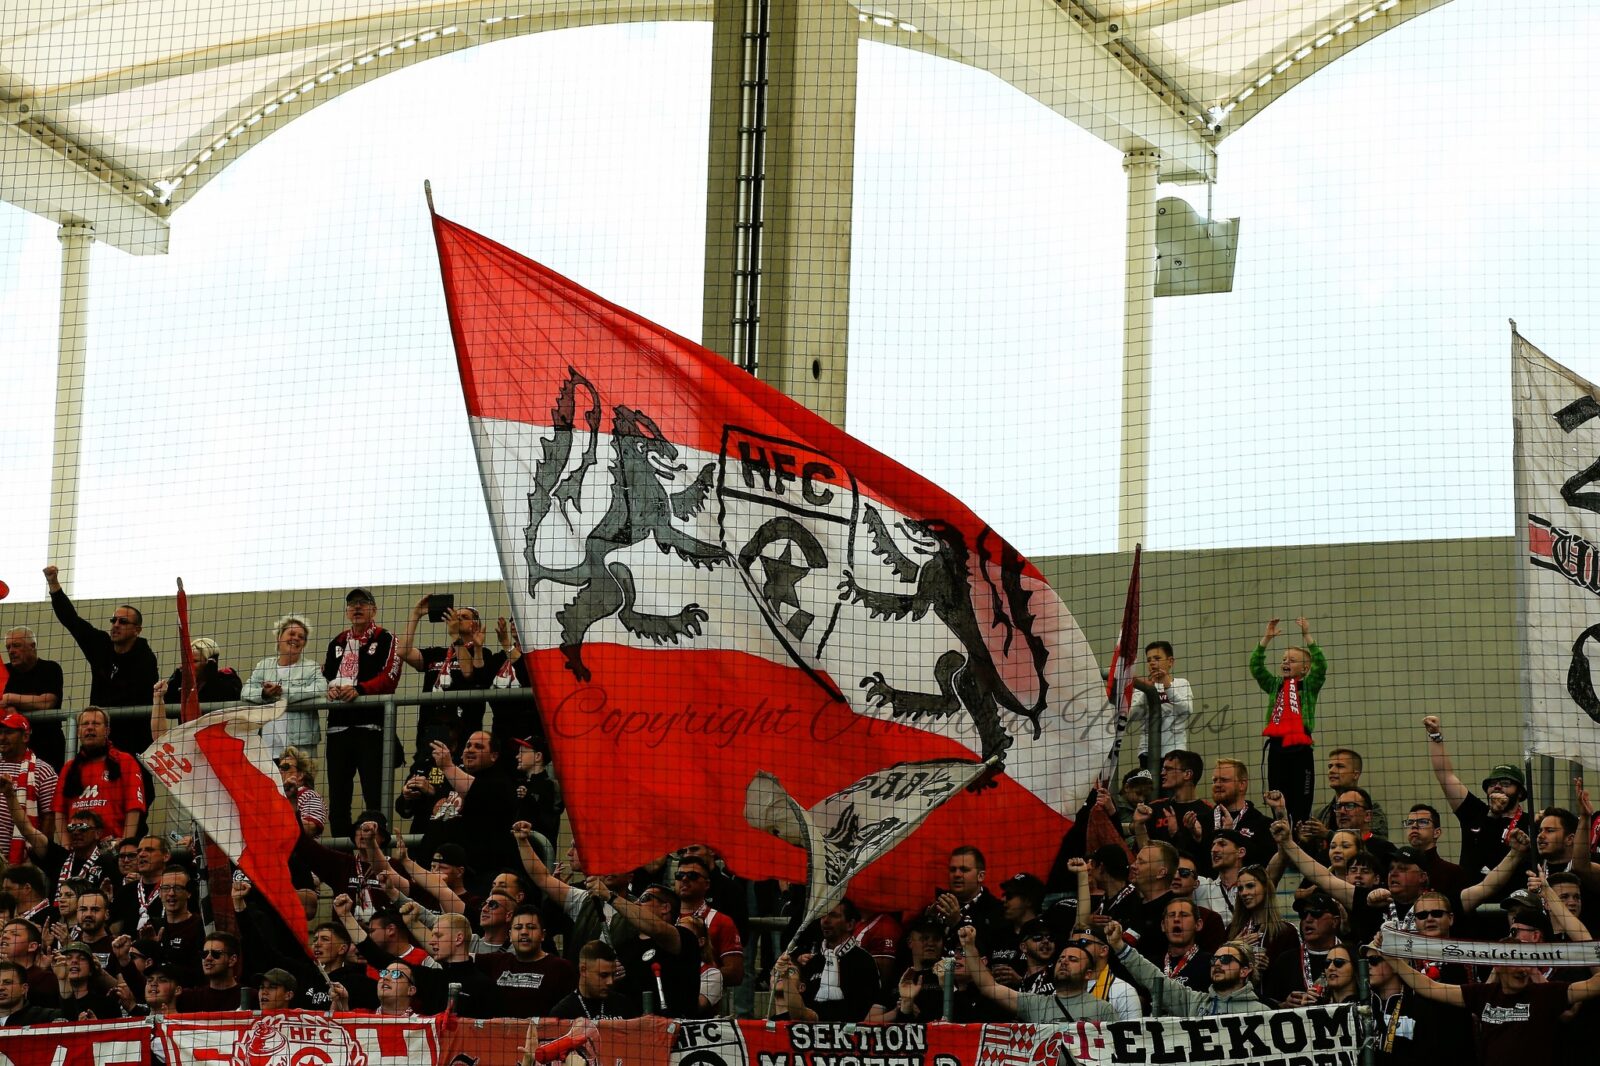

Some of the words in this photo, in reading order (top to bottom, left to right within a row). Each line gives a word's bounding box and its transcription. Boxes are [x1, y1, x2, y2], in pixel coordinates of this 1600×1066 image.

[738, 441, 836, 506] HFC
[146, 743, 192, 787] HFC
[1442, 944, 1563, 961] Saalefront
[289, 1026, 333, 1043] HFC
[791, 1023, 926, 1051] SEKTION
[1072, 1006, 1354, 1063] TELEKOM
